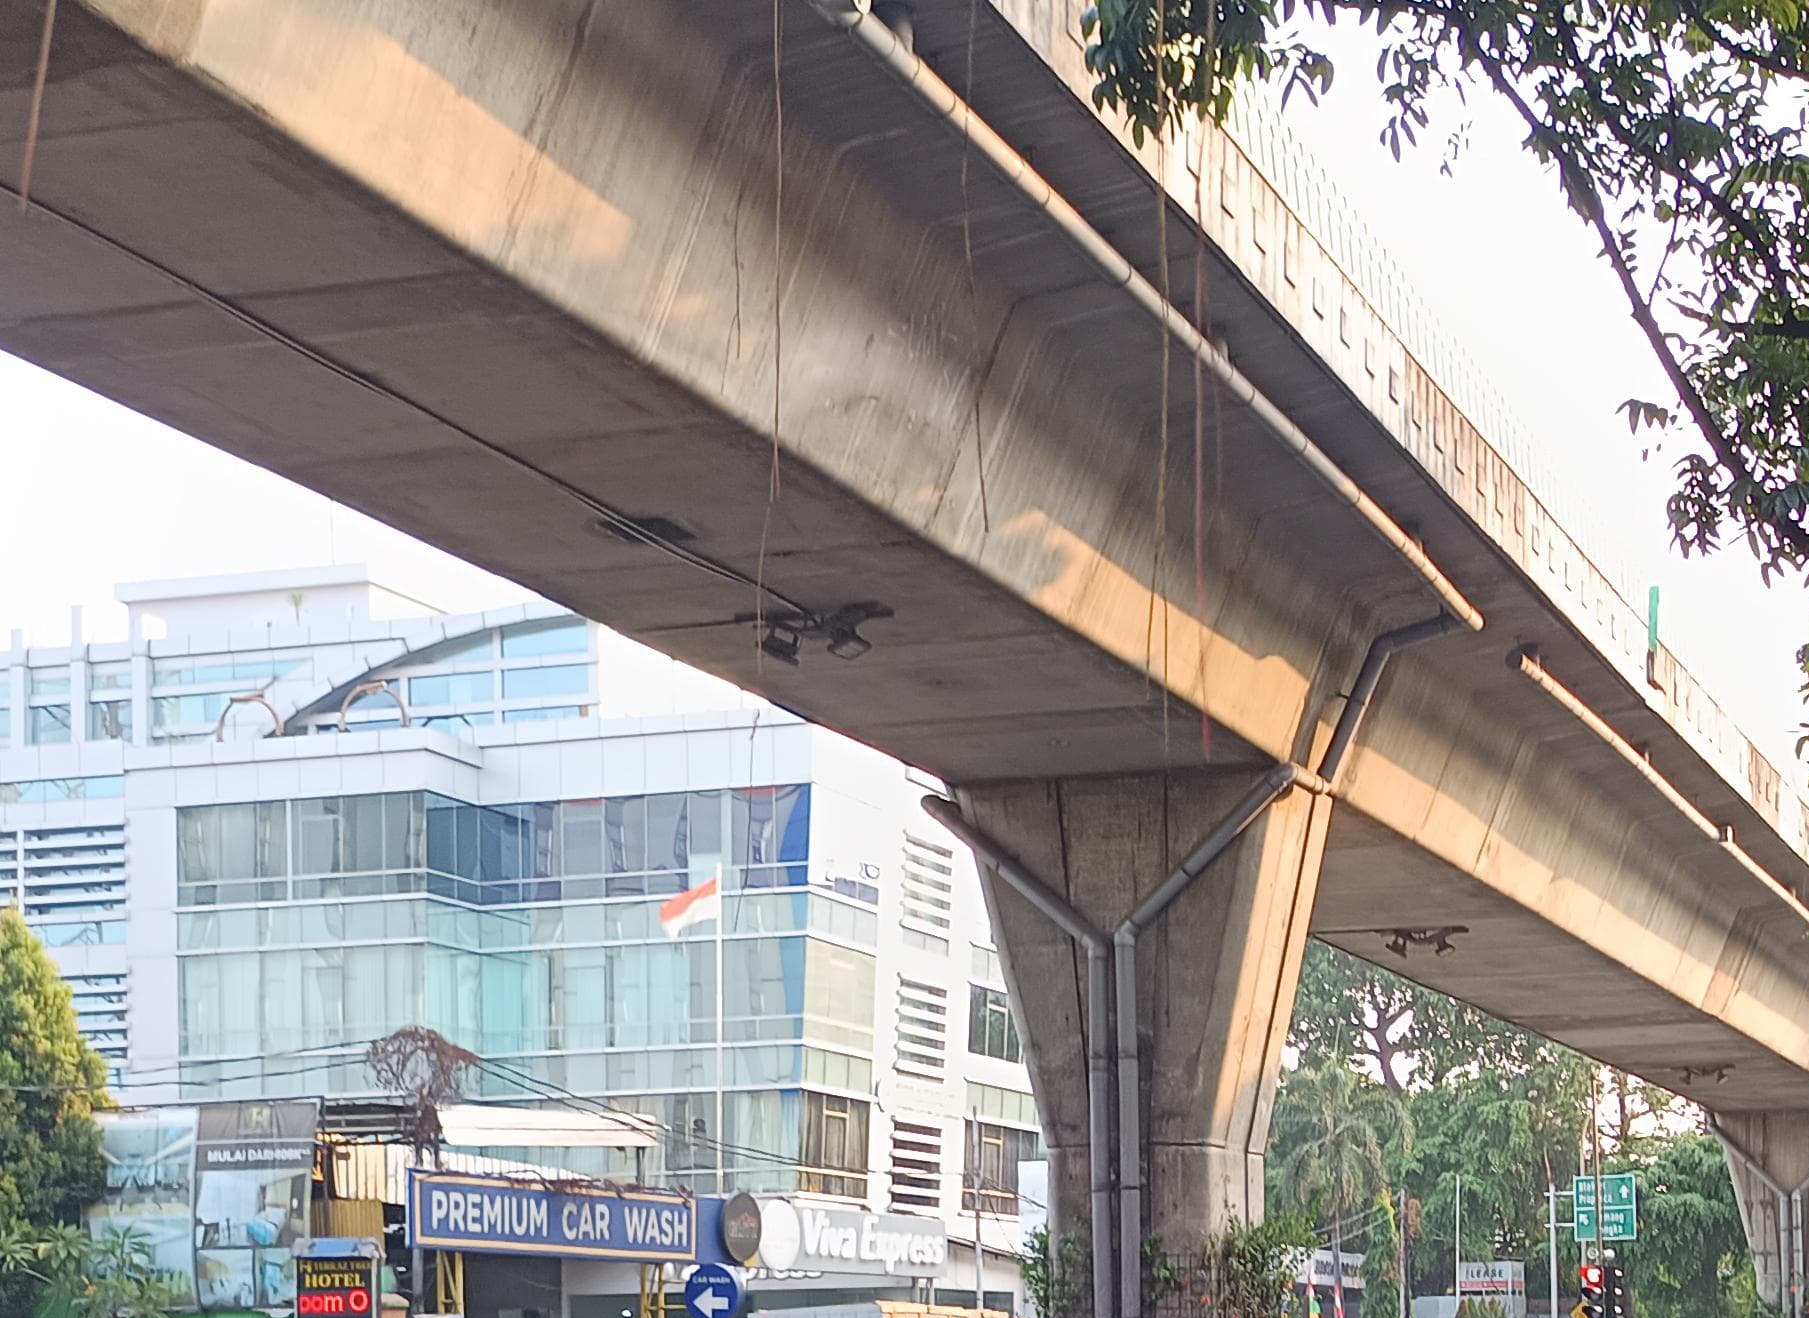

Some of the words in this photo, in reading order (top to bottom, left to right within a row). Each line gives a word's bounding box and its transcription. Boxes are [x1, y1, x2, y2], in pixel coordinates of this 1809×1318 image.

[207, 1149, 246, 1163] MULAI
[431, 1190, 548, 1238] PREMIUM
[562, 1202, 610, 1241] CAR
[624, 1206, 688, 1247] WASH
[801, 1208, 857, 1258] Viva
[859, 1213, 945, 1274] Express
[305, 1272, 365, 1288] HOTEL
[692, 1275, 707, 1284] CAR
[709, 1275, 731, 1284] WASH
